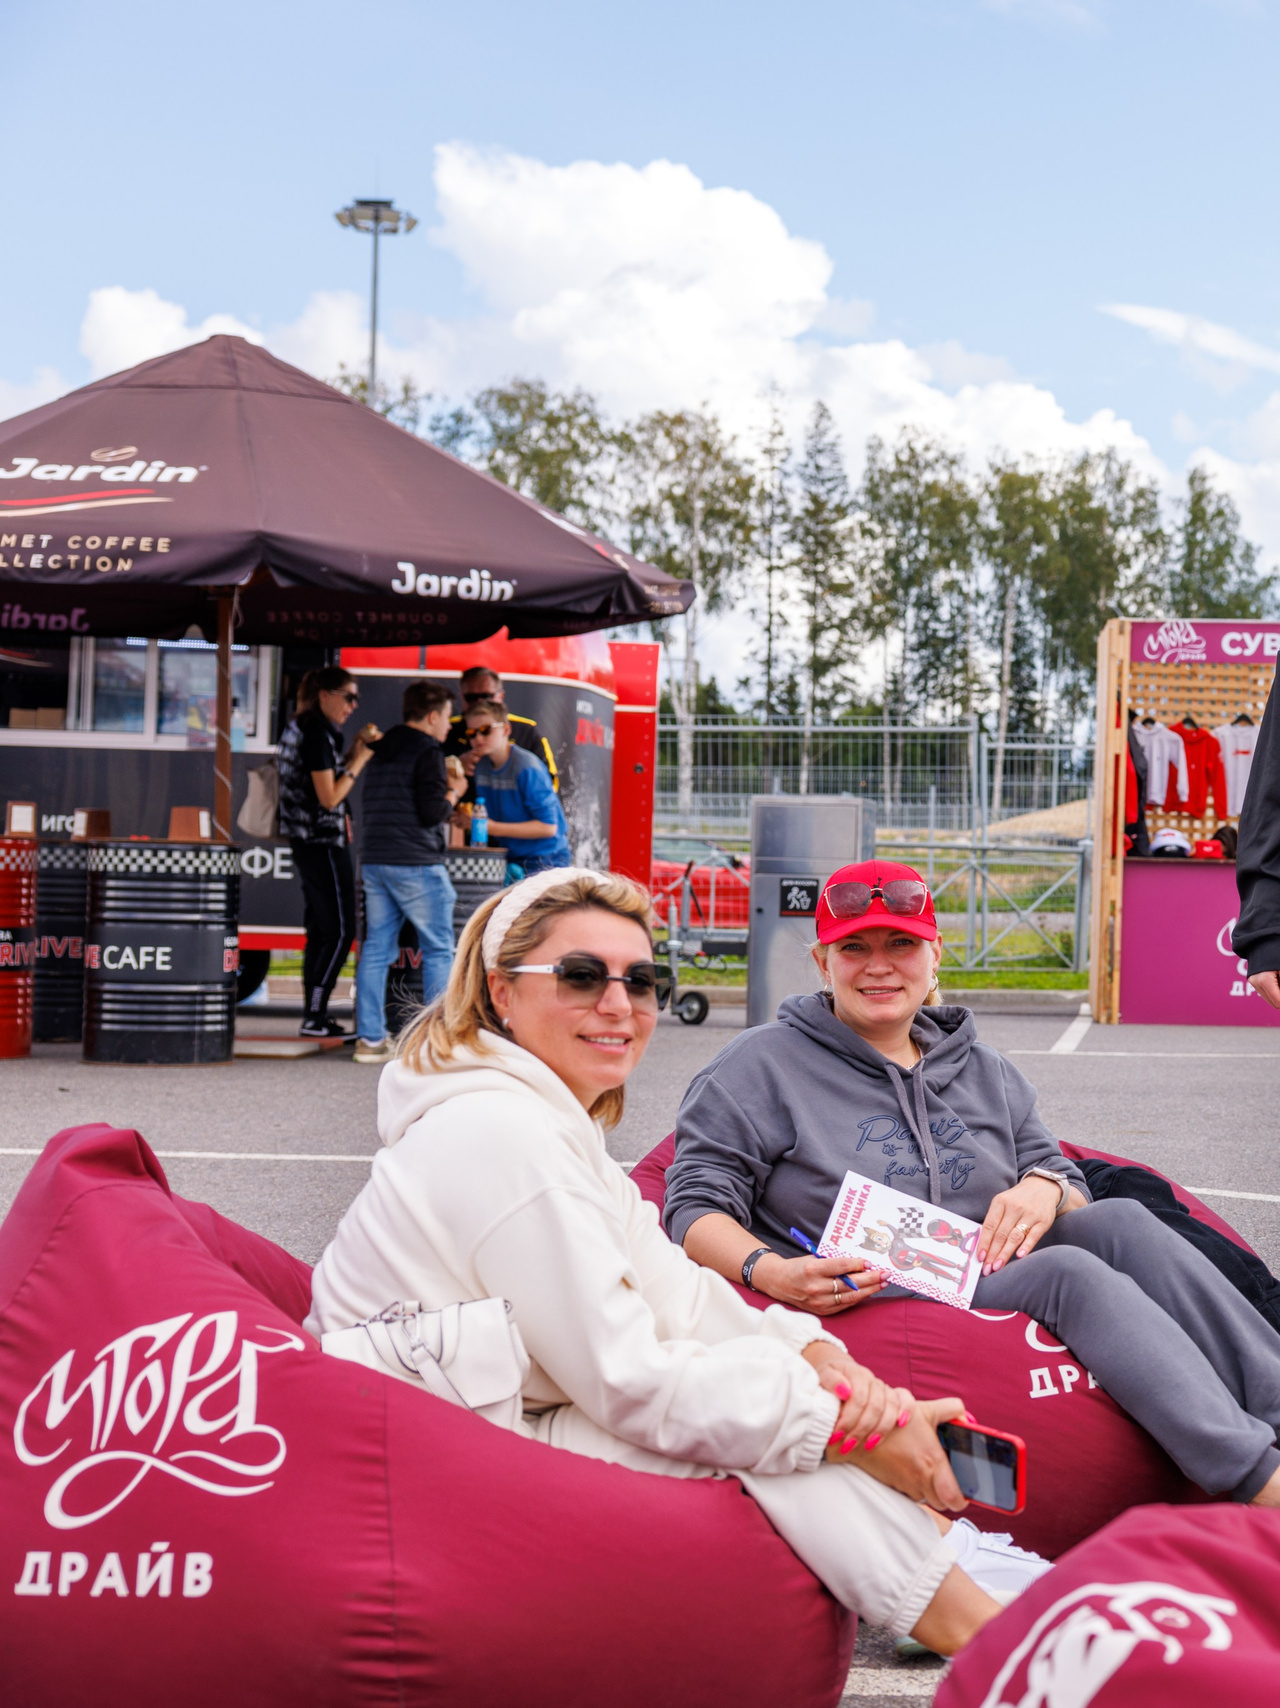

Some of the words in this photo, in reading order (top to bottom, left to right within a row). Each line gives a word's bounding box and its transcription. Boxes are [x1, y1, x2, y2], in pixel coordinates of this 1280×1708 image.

[0, 457, 200, 483] Jardin
[67, 535, 172, 553] COFFEE
[391, 561, 515, 602] Jardin
[240, 846, 294, 879] ФЕ
[103, 945, 172, 971] CAFE
[882, 1142, 904, 1157] is
[830, 1187, 858, 1247] ДНЕВНИК
[844, 1184, 872, 1240] ГОНЩИКА
[14, 1541, 214, 1598] ДРАЙВ
